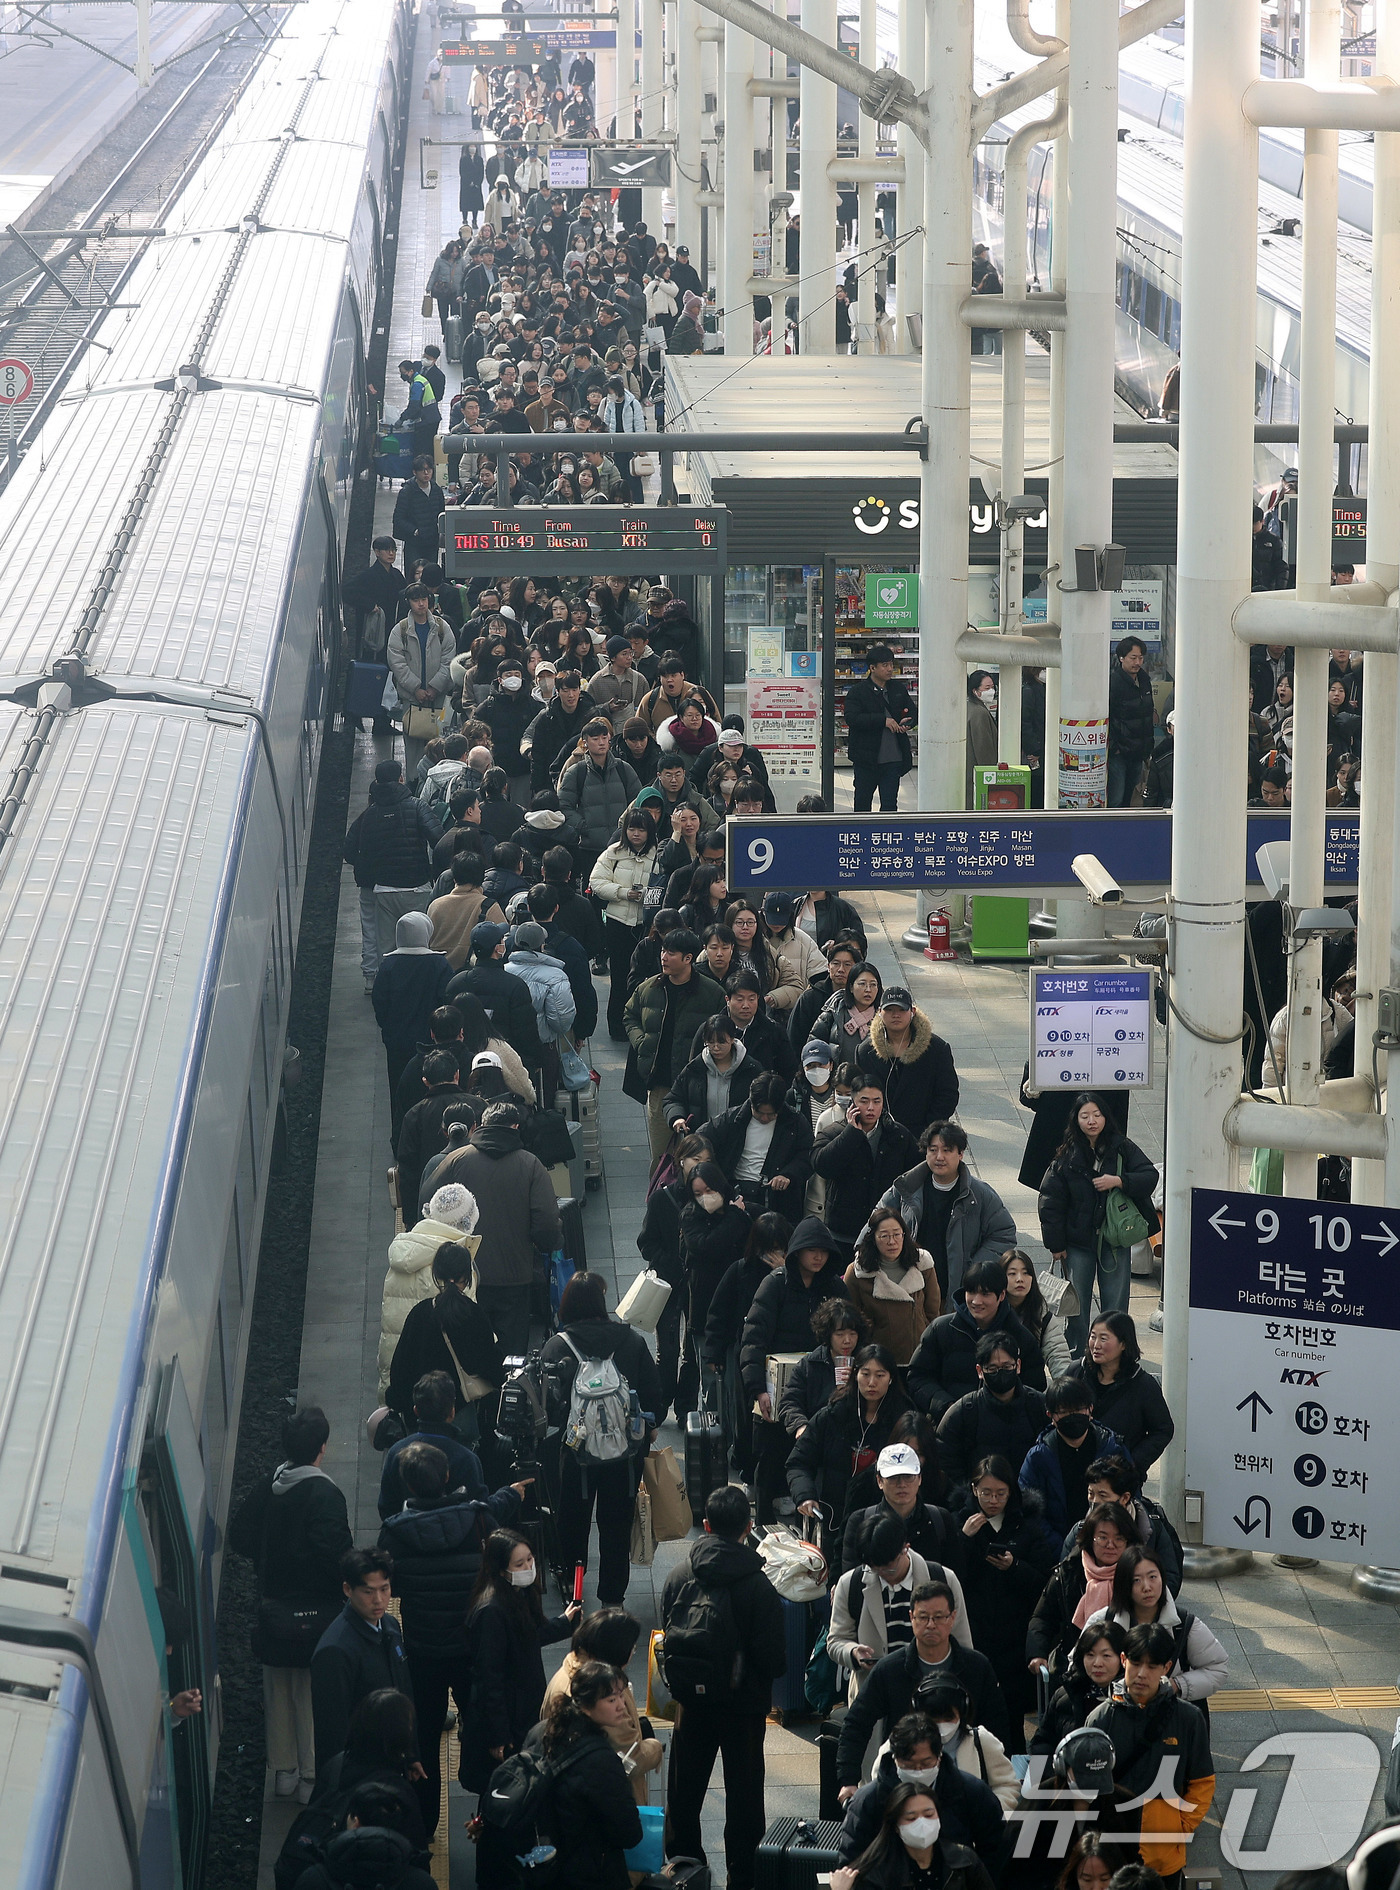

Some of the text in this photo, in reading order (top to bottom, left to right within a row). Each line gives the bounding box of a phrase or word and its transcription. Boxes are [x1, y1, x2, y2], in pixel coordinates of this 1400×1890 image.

[5, 366, 15, 381] 8
[6, 383, 15, 397] 6
[1334, 509, 1361, 520] Time
[491, 519, 716, 532] Time From Train Delay
[1334, 523, 1367, 537] 10:5
[454, 533, 711, 549] THIS 10:49 Busan KTX 0
[838, 830, 1034, 845] 대전 동대구 부산 포항 진주 마산
[1330, 828, 1360, 841] 동대구
[747, 837, 775, 875] 9
[945, 845, 969, 853] Pohang
[838, 854, 1035, 869] 익산 광주송정 목포 여수EXPO 방면
[1326, 852, 1348, 864] 익산
[924, 869, 946, 877] Mokpo
[977, 869, 993, 877] Expo
[1042, 980, 1088, 994] 호차번호
[1037, 1005, 1064, 1016] KTX
[1060, 1031, 1071, 1041] 10
[1073, 1032, 1090, 1042] 호차
[1128, 1031, 1144, 1041] 호차
[1037, 1049, 1059, 1058] KTX
[1096, 1047, 1120, 1056] 무궁화
[1073, 1072, 1090, 1082] 호차
[1128, 1071, 1144, 1081] 호차
[1255, 1208, 1352, 1253] 9 10
[1259, 1261, 1346, 1299] 타는 곳
[1238, 1290, 1364, 1317] Platforms 站台 のりば
[1264, 1321, 1337, 1348] 호차번호
[1274, 1347, 1326, 1362] Car number
[1280, 1368, 1330, 1387] KTX
[1298, 1406, 1370, 1441] 18 호차
[1233, 1453, 1273, 1475] 현위치
[1332, 1468, 1368, 1493] 호차
[1330, 1520, 1367, 1546] 호차
